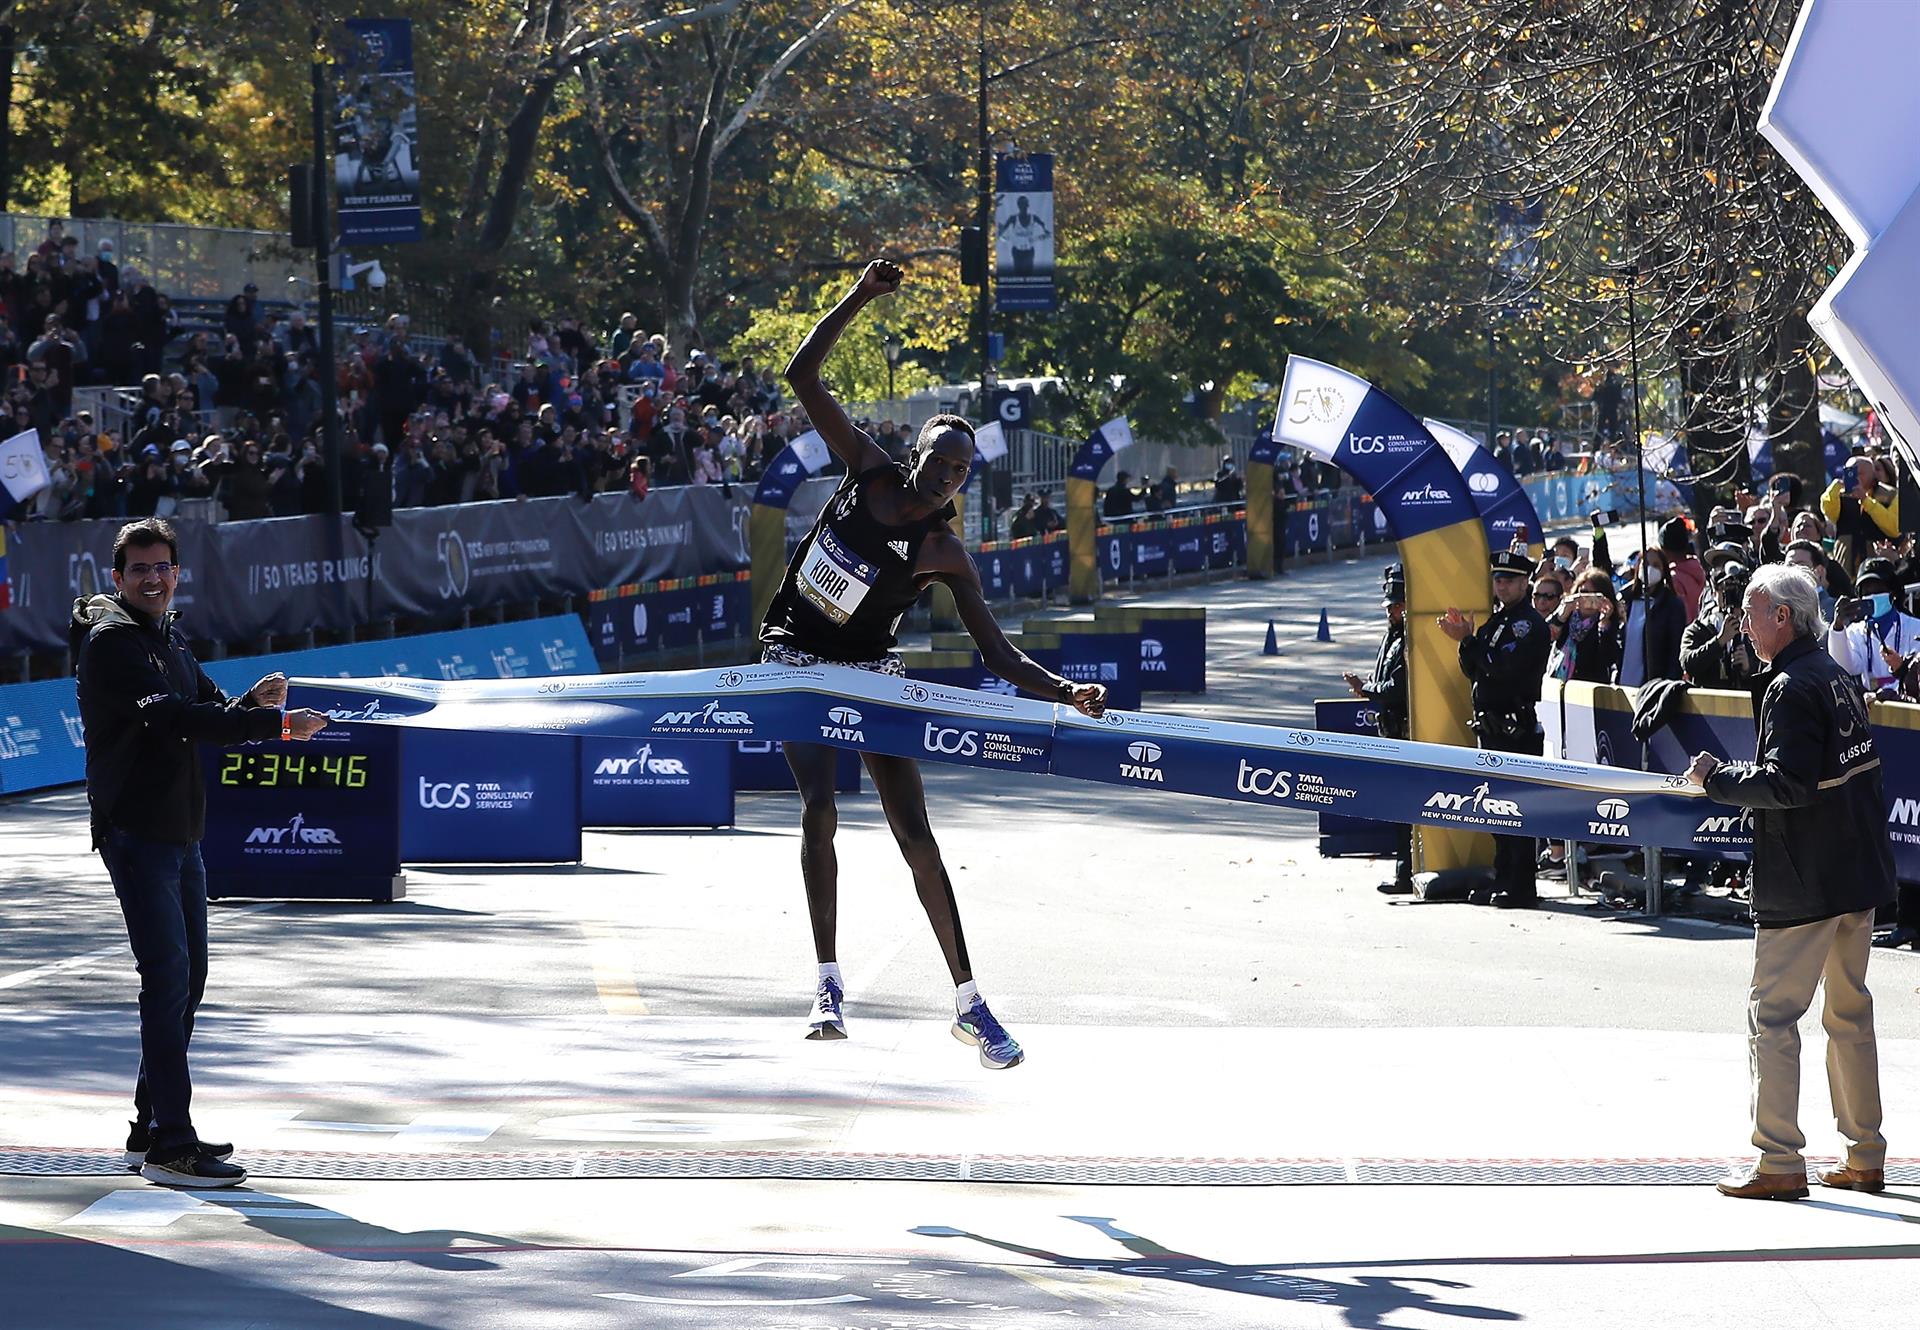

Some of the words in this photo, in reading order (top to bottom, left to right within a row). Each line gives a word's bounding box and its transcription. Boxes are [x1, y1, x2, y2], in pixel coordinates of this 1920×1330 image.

[1000, 398, 1021, 422] G
[1350, 432, 1385, 454] tcs
[887, 541, 908, 561] adidas
[263, 564, 281, 590] 50
[809, 557, 850, 602] KORIR
[1061, 664, 1097, 672] NITED
[1140, 661, 1167, 672] ATA
[715, 671, 743, 688] 50
[136, 695, 153, 709] tcs
[900, 684, 929, 703] 50
[654, 708, 755, 725] NYRR
[820, 725, 865, 743] TATA
[923, 721, 978, 758] tcs
[984, 732, 1011, 744] TATA
[1286, 731, 1315, 746] 50
[981, 751, 1021, 767] SERVICES
[982, 741, 1044, 761] CONSULTANCY
[1839, 745, 1860, 765] CLASS
[1860, 738, 1873, 754] OF
[594, 755, 689, 775] NYRR
[1475, 752, 1503, 768] 50
[1119, 764, 1164, 782] TATA
[1236, 758, 1291, 799] tcs
[1298, 774, 1324, 785] TATA
[419, 776, 471, 809] tcs
[475, 783, 501, 791] TATA
[475, 791, 534, 800] CONSULTANCY
[1296, 782, 1357, 799] CONSULTANCY
[475, 800, 513, 809] SERVICES
[1294, 792, 1333, 805] SERVICES
[1424, 790, 1523, 817] NYRR
[1421, 810, 1442, 818] NEW
[1441, 812, 1463, 822] YORK
[1463, 816, 1485, 825] ROAD
[1486, 818, 1523, 829] RUNNERS
[245, 824, 342, 844] NYRR
[1588, 821, 1630, 838] TATA
[1711, 836, 1731, 844] YORK
[1732, 837, 1754, 845] ROAD
[244, 847, 262, 855] NEW
[263, 847, 283, 855] YORK
[284, 847, 306, 855] ROAD
[307, 847, 343, 855] RUNNERS
